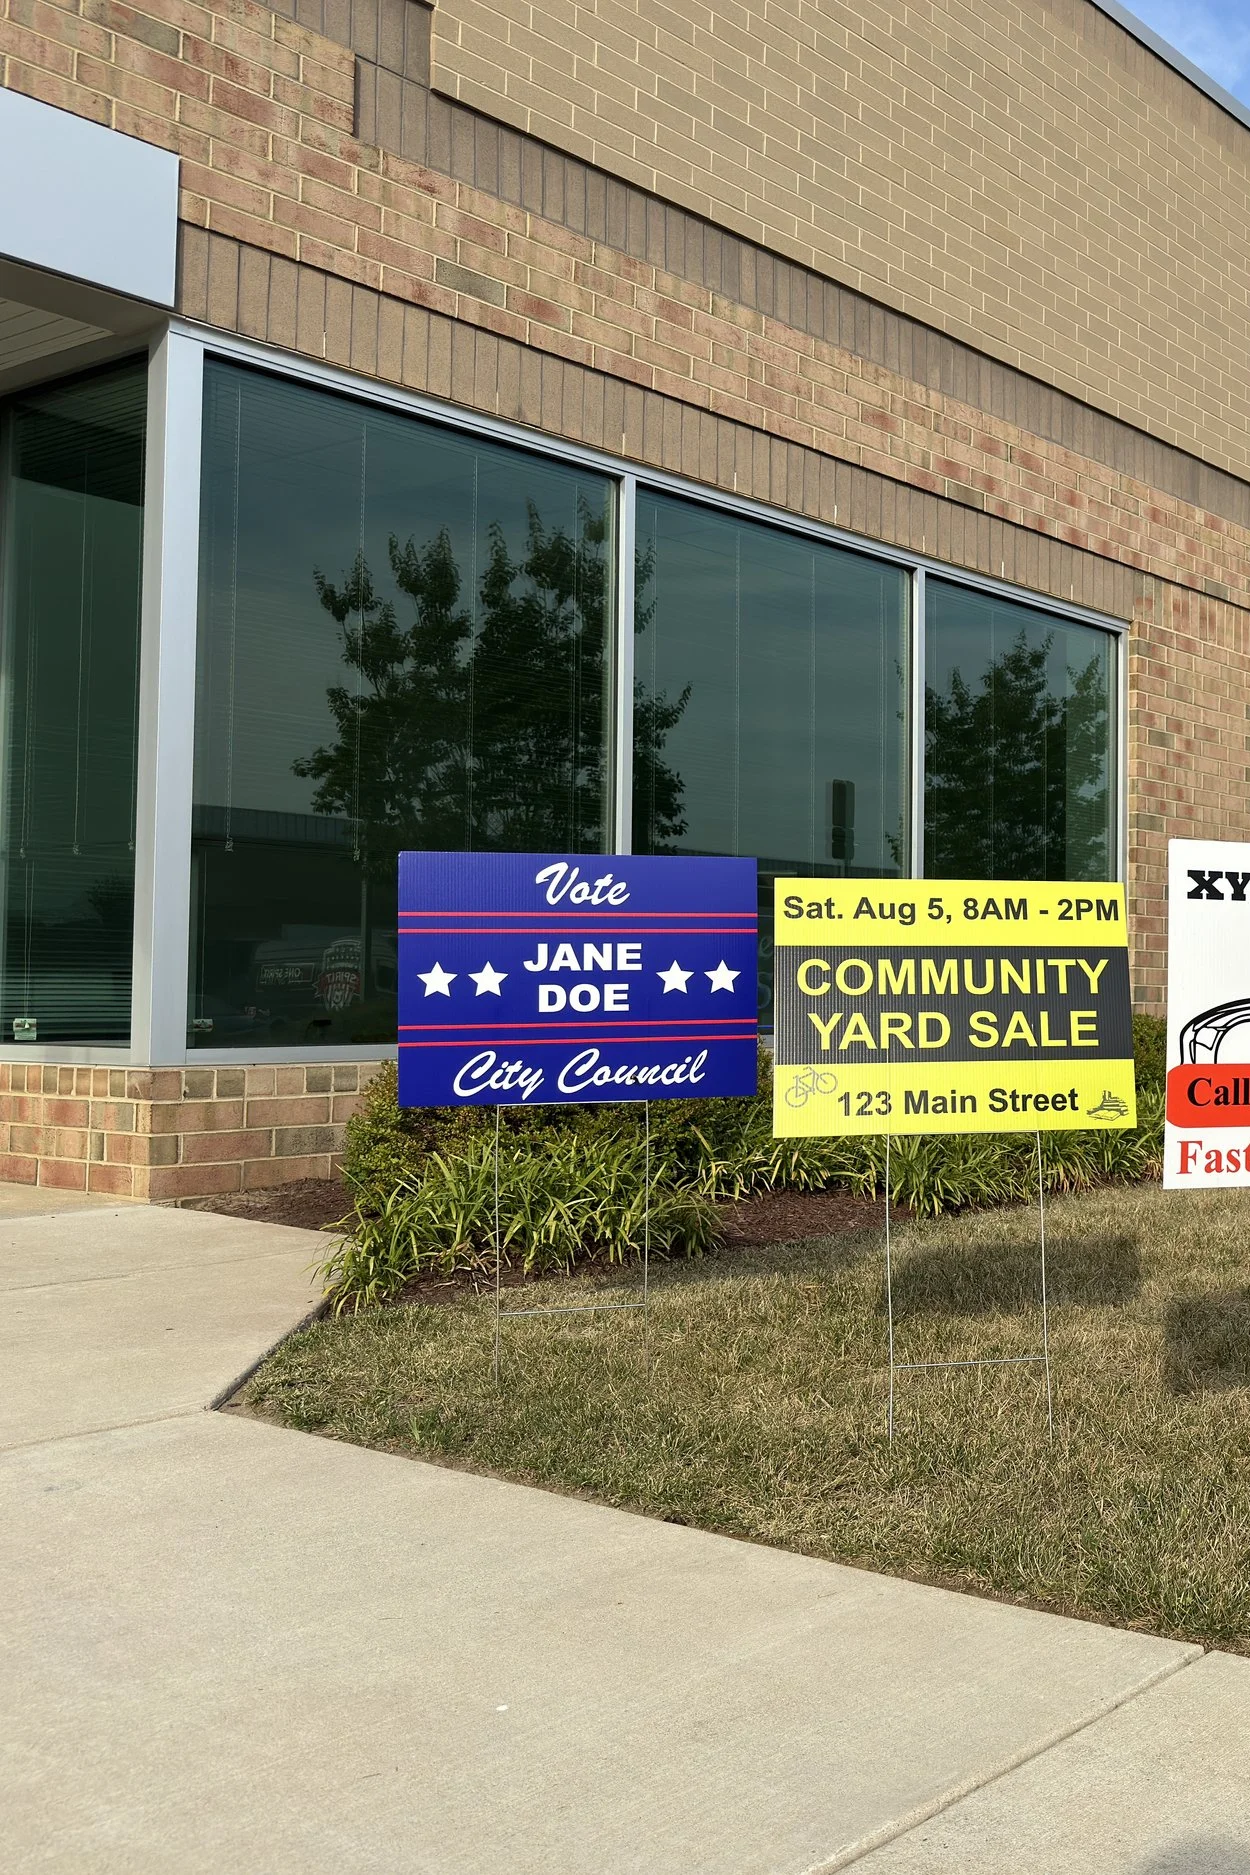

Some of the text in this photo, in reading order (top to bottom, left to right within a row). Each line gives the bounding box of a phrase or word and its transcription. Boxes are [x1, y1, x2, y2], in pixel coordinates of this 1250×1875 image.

[536, 862, 630, 905] Vote
[784, 896, 842, 919] Sat.
[854, 897, 915, 925] Aug
[928, 898, 951, 923] 5,
[964, 898, 1027, 920] 8AM
[1058, 899, 1118, 920] 2PM
[524, 943, 642, 971] JANE
[796, 957, 1109, 996] COMMUNITY
[539, 984, 629, 1012] DOE
[807, 1011, 1098, 1051] YARD SALE
[453, 1048, 707, 1101] City Council
[838, 1089, 1078, 1117] 123 Main Street
[1188, 1078, 1250, 1106] Call
